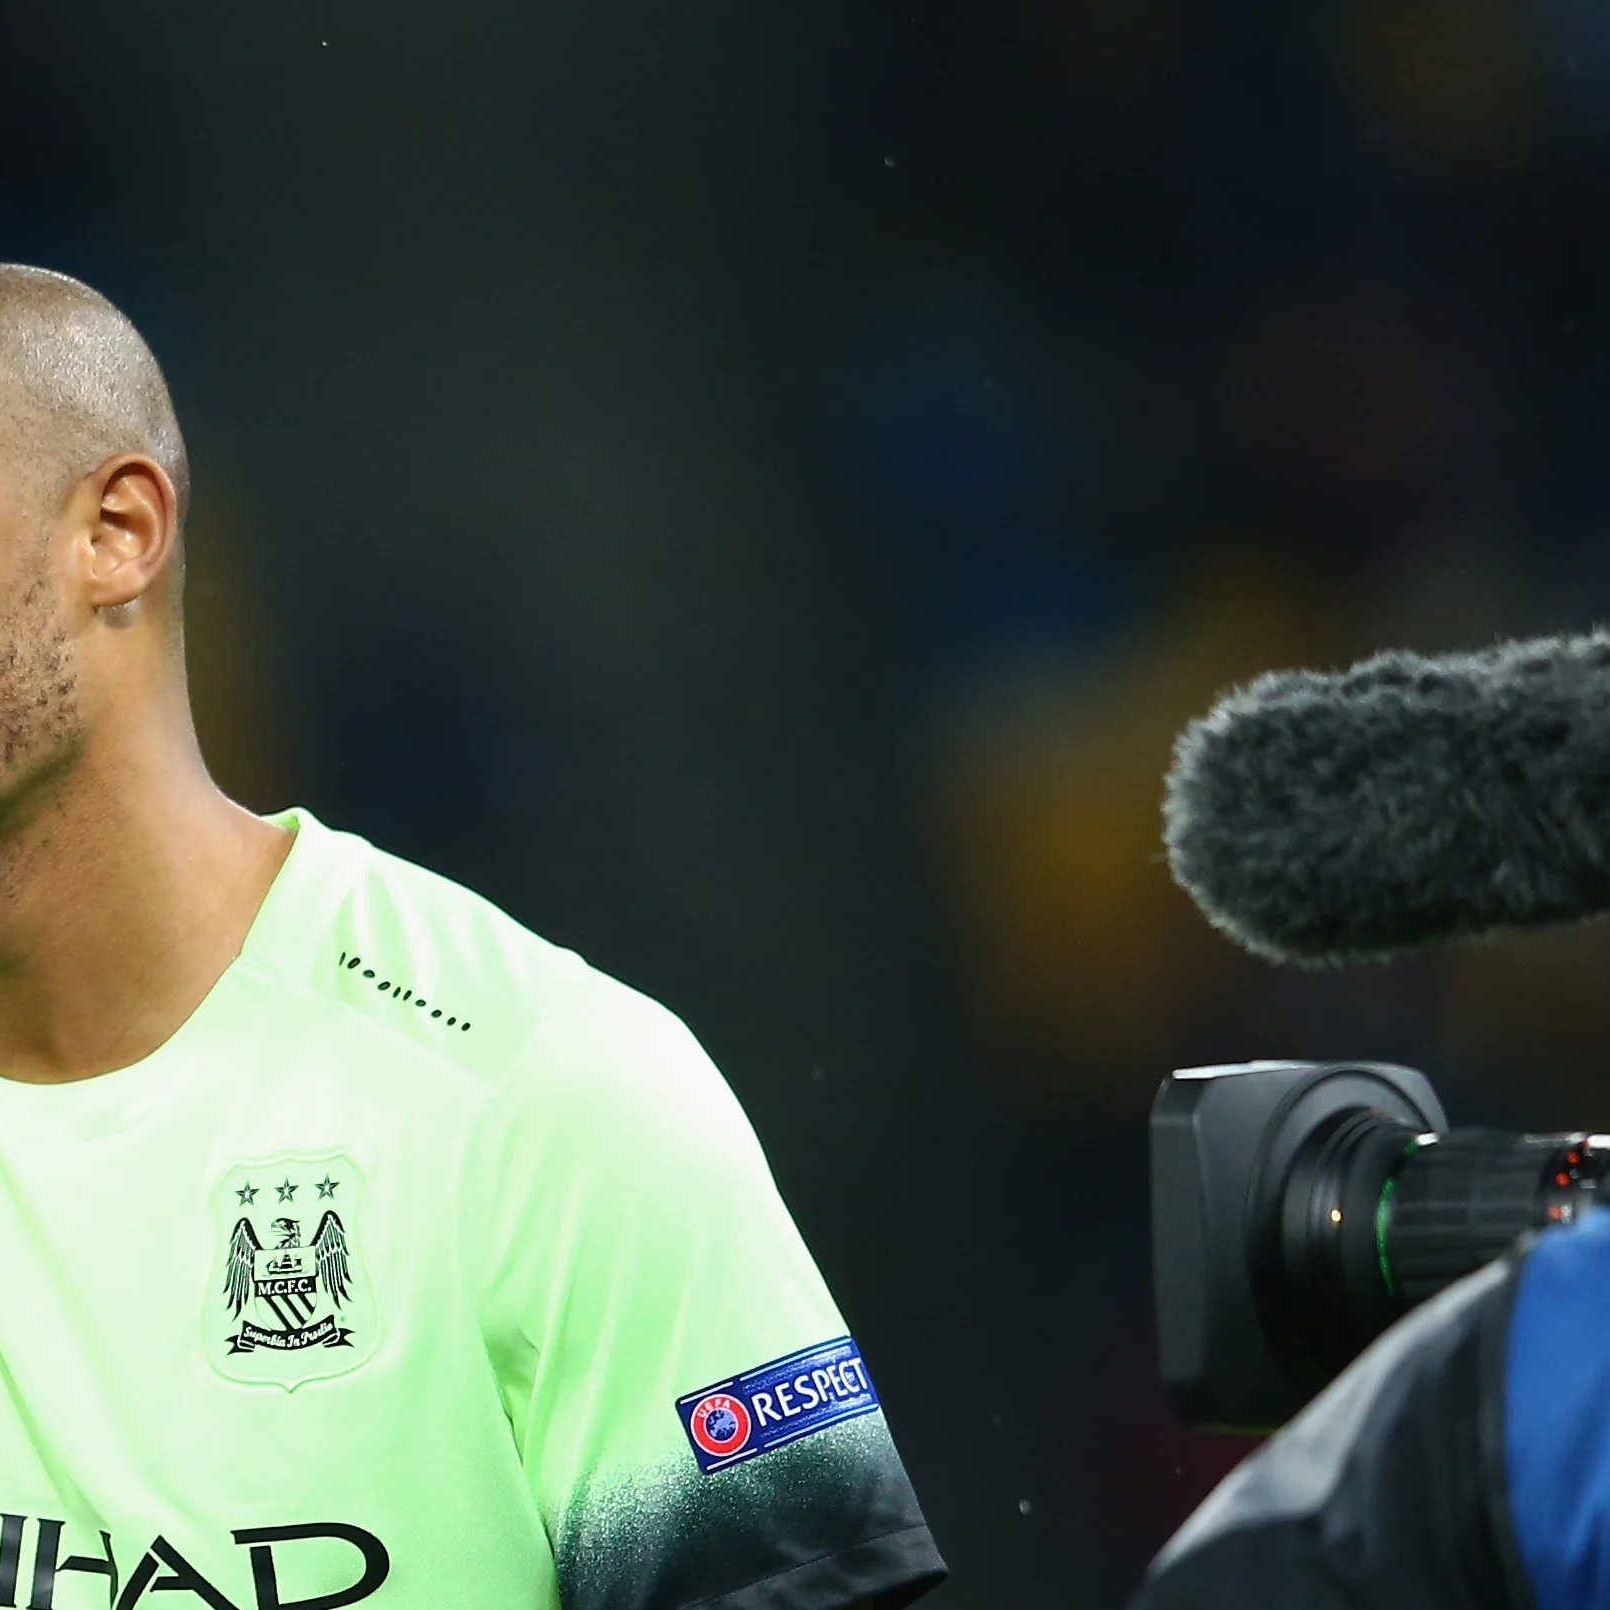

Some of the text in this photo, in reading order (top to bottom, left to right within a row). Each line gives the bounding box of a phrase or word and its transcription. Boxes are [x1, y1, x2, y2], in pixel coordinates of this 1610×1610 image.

[258, 1279, 312, 1295] M.C.F.C.
[751, 1357, 869, 1427] RESPECT
[697, 1400, 733, 1419] UEFA
